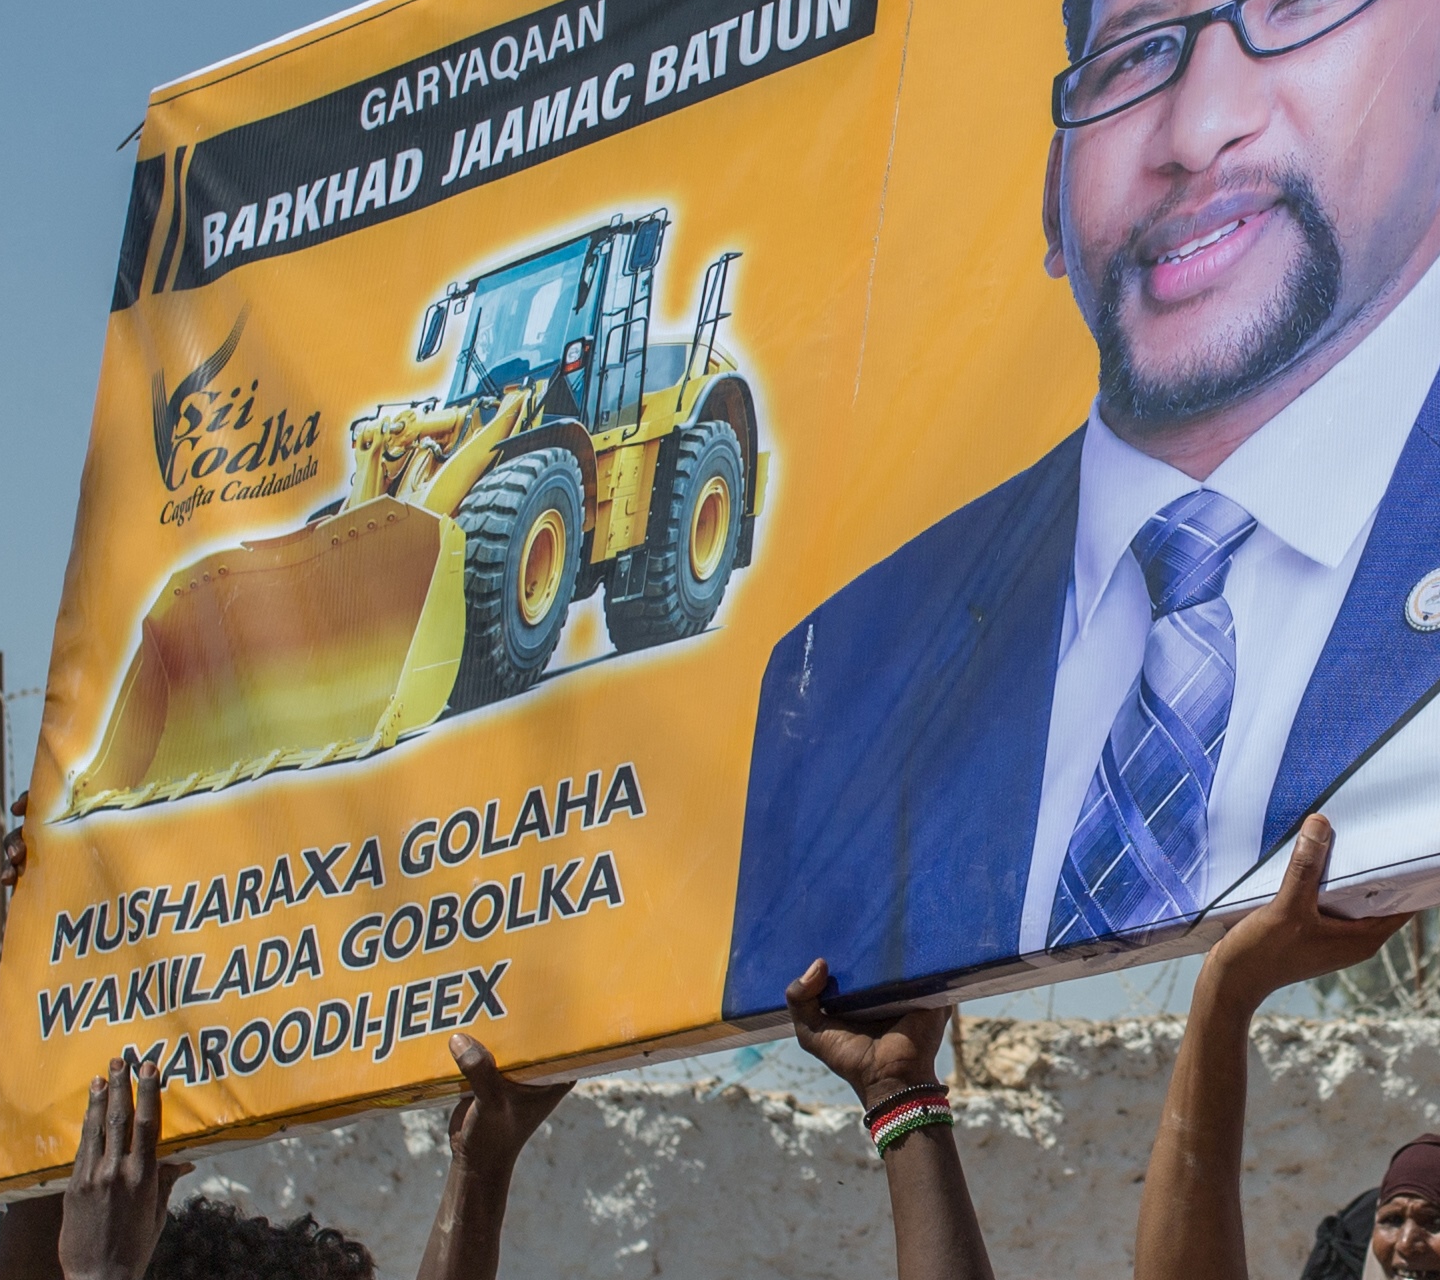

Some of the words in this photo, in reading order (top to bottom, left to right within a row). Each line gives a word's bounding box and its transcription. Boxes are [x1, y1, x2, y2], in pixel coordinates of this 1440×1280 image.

[360, 0, 606, 131] GARYAQAAN
[203, 147, 423, 269] BARKHAD
[441, 64, 632, 185] JAAMAC
[160, 485, 214, 527] Cagafta
[220, 455, 318, 502] Caddaalada
[166, 408, 321, 492] Codka
[50, 837, 384, 964] MUSHARAXA
[399, 762, 645, 878] GOLAHA
[37, 925, 322, 1040] WAKIILADA
[340, 851, 624, 970] GOBOLKA
